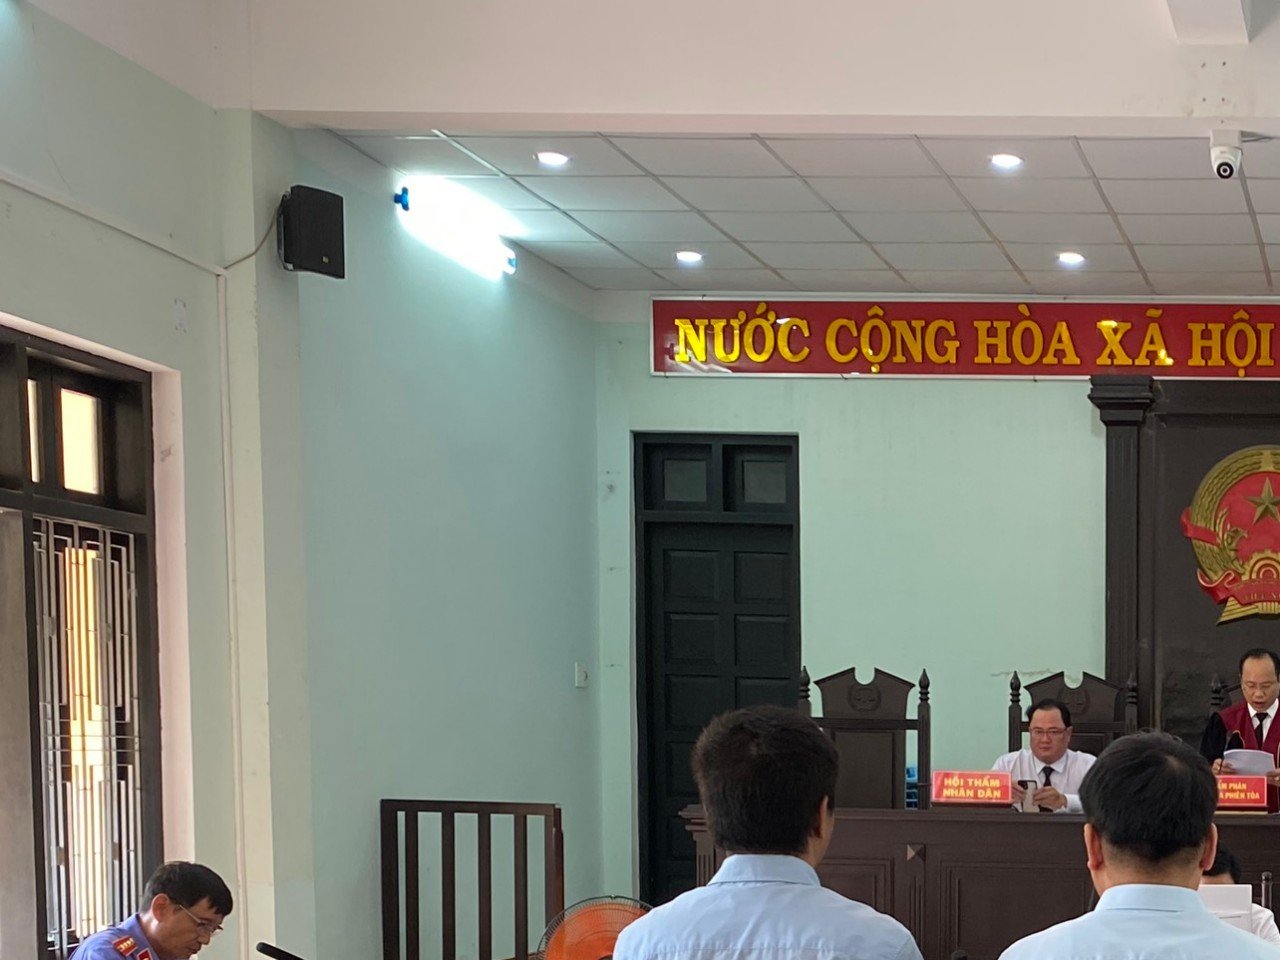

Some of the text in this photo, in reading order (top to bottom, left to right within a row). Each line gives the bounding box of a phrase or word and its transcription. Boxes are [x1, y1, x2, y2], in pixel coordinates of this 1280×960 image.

[673, 303, 811, 363] NƯỚC
[826, 307, 960, 374] CỘNG
[974, 304, 1081, 366] HÒA
[1096, 309, 1174, 367] XÃ
[1187, 310, 1275, 377] HỘI
[944, 775, 1000, 787] HỘI THẨM
[942, 788, 1001, 798] NHÂN DÂN
[1225, 791, 1245, 800] PHIÊN
[1246, 790, 1260, 799] TÒA
